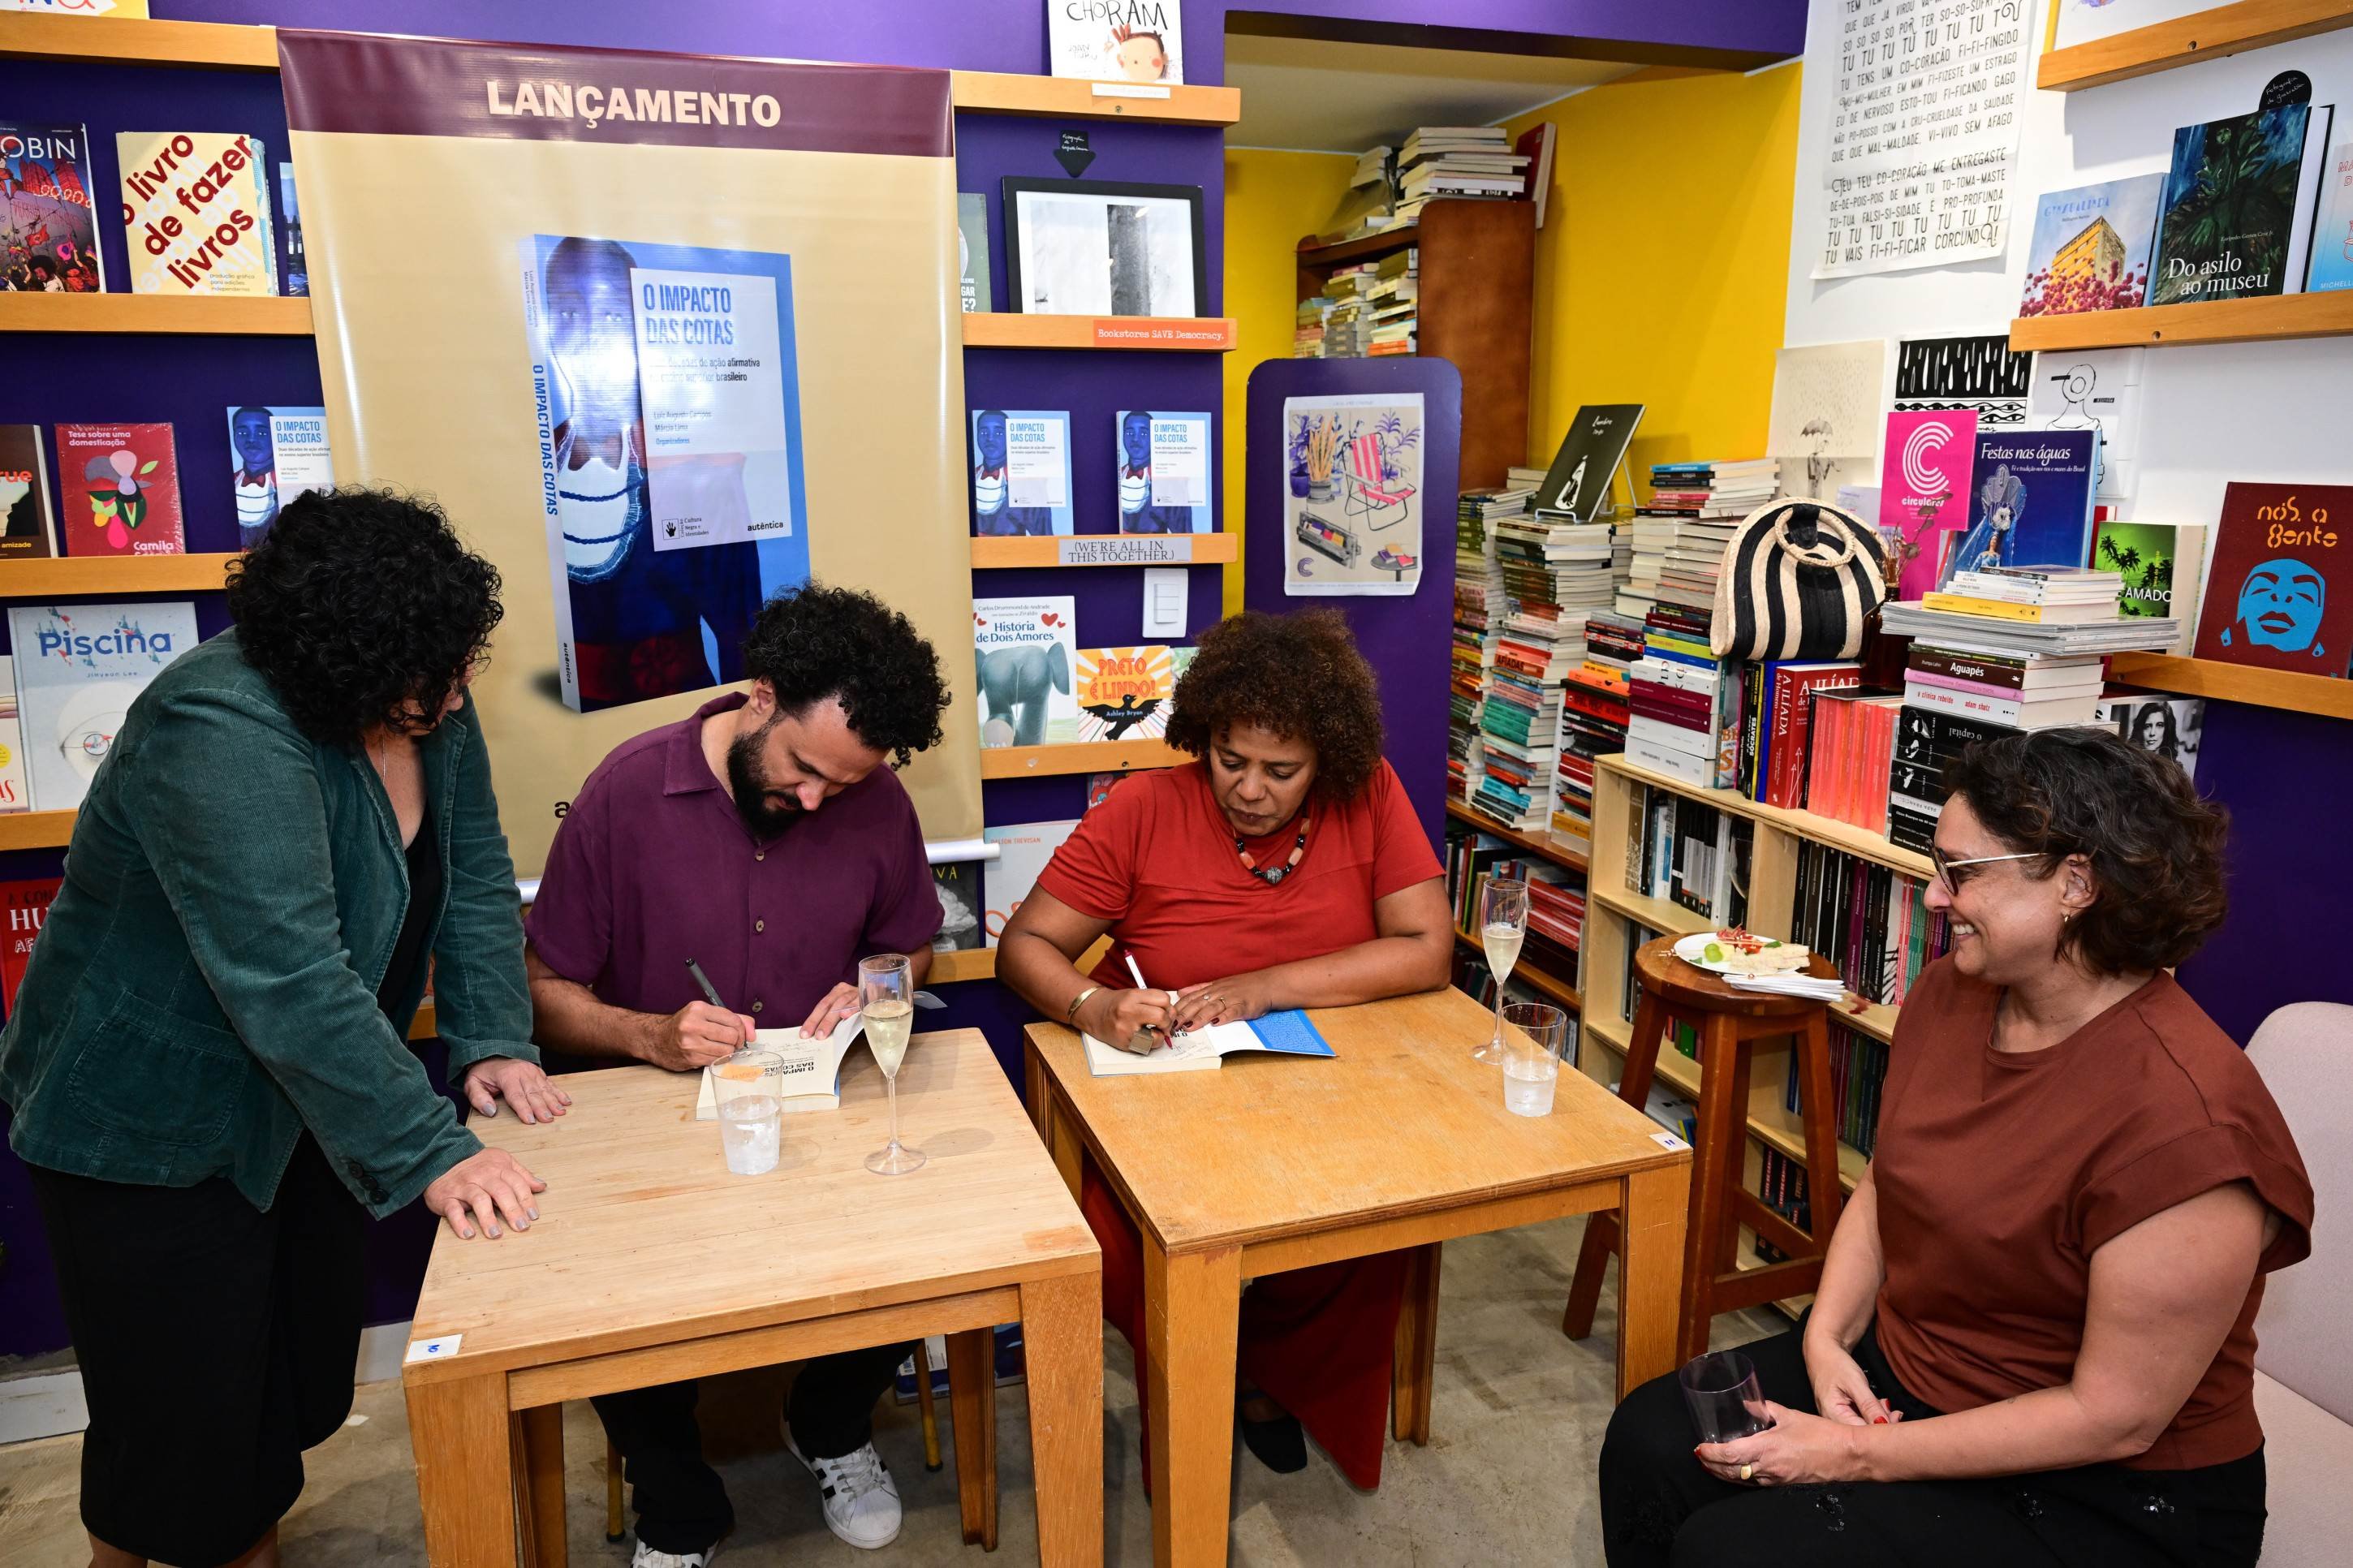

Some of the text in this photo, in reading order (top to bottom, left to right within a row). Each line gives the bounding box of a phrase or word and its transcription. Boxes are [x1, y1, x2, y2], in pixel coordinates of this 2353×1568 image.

[1067, 0, 1168, 30] CHORAM
[1841, 78, 1850, 91] TU
[1857, 71, 1875, 86] TENS
[1881, 65, 1892, 80] UM
[1959, 28, 2019, 58] FI-FI-FINGIDO
[1897, 82, 1906, 94] EM
[1911, 77, 1924, 89] MIM
[1969, 62, 1980, 74] UM
[1985, 51, 2017, 70] ESTRAGO
[487, 80, 781, 128] LANÇAMENTO
[1836, 115, 1845, 127] EU
[1850, 111, 1858, 124] DE
[1864, 102, 1894, 120] NERVOSO
[1994, 71, 2015, 88] GAGO
[1883, 120, 1896, 133] COM
[1902, 118, 1906, 129] A
[1969, 102, 1977, 114] DA
[1984, 93, 2014, 110] SAUDADE
[1832, 149, 1844, 162] QUE
[1850, 145, 1862, 158] QUE
[1929, 124, 1959, 141] VI-VIVO
[1964, 119, 1980, 134] SEM
[1987, 112, 2012, 128] AFAGO
[126, 135, 193, 201] livro
[1858, 174, 1872, 189] TEU
[1933, 159, 1946, 174] ME
[1952, 147, 2007, 170] ENTREGASTE
[145, 136, 253, 256] de fazer
[1828, 205, 2002, 247] TU TU TU TU TU TU TU TU
[167, 209, 253, 289] livros
[1825, 250, 1837, 265] TU
[1846, 246, 1863, 262] VAIS
[1870, 236, 1927, 259] FI-FI-FICAR
[2168, 251, 2241, 278] Do asilo
[2180, 274, 2269, 295] ao museu
[643, 284, 731, 313] O IMPACTO
[646, 317, 735, 345] DAS COTAS
[1098, 330, 1224, 340] Bookstores SAVE Democracy.
[728, 358, 760, 367] afirmativa
[717, 373, 748, 381] brasileiro
[276, 421, 320, 431] O IMPACTO
[1016, 424, 1044, 432] IMPACTO
[1161, 424, 1187, 433] IMPACTO
[278, 433, 321, 442] DAS COTAS
[532, 364, 558, 516] O IMPACTO DAS COTAS
[1155, 434, 1187, 442] DAS COTAS
[1981, 443, 2071, 466] Festas nas águas
[748, 521, 783, 531] autêntica
[2268, 523, 2338, 549] gente
[134, 541, 174, 551] Camila
[1069, 552, 1097, 562] THIS
[1120, 541, 1144, 551] ALL
[1149, 541, 1163, 550] IN
[2126, 587, 2172, 602] AMADO
[976, 631, 1054, 643] de Dois Amores
[994, 622, 1035, 631] História
[39, 628, 172, 657] Piscina
[1099, 658, 1147, 676] PRETO
[1950, 662, 1984, 677] Aguapés
[1090, 678, 1155, 700] É LINDO!
[1799, 681, 1809, 696] A
[1779, 675, 1791, 735] A ILÍADA
[1950, 727, 1975, 739] capital
